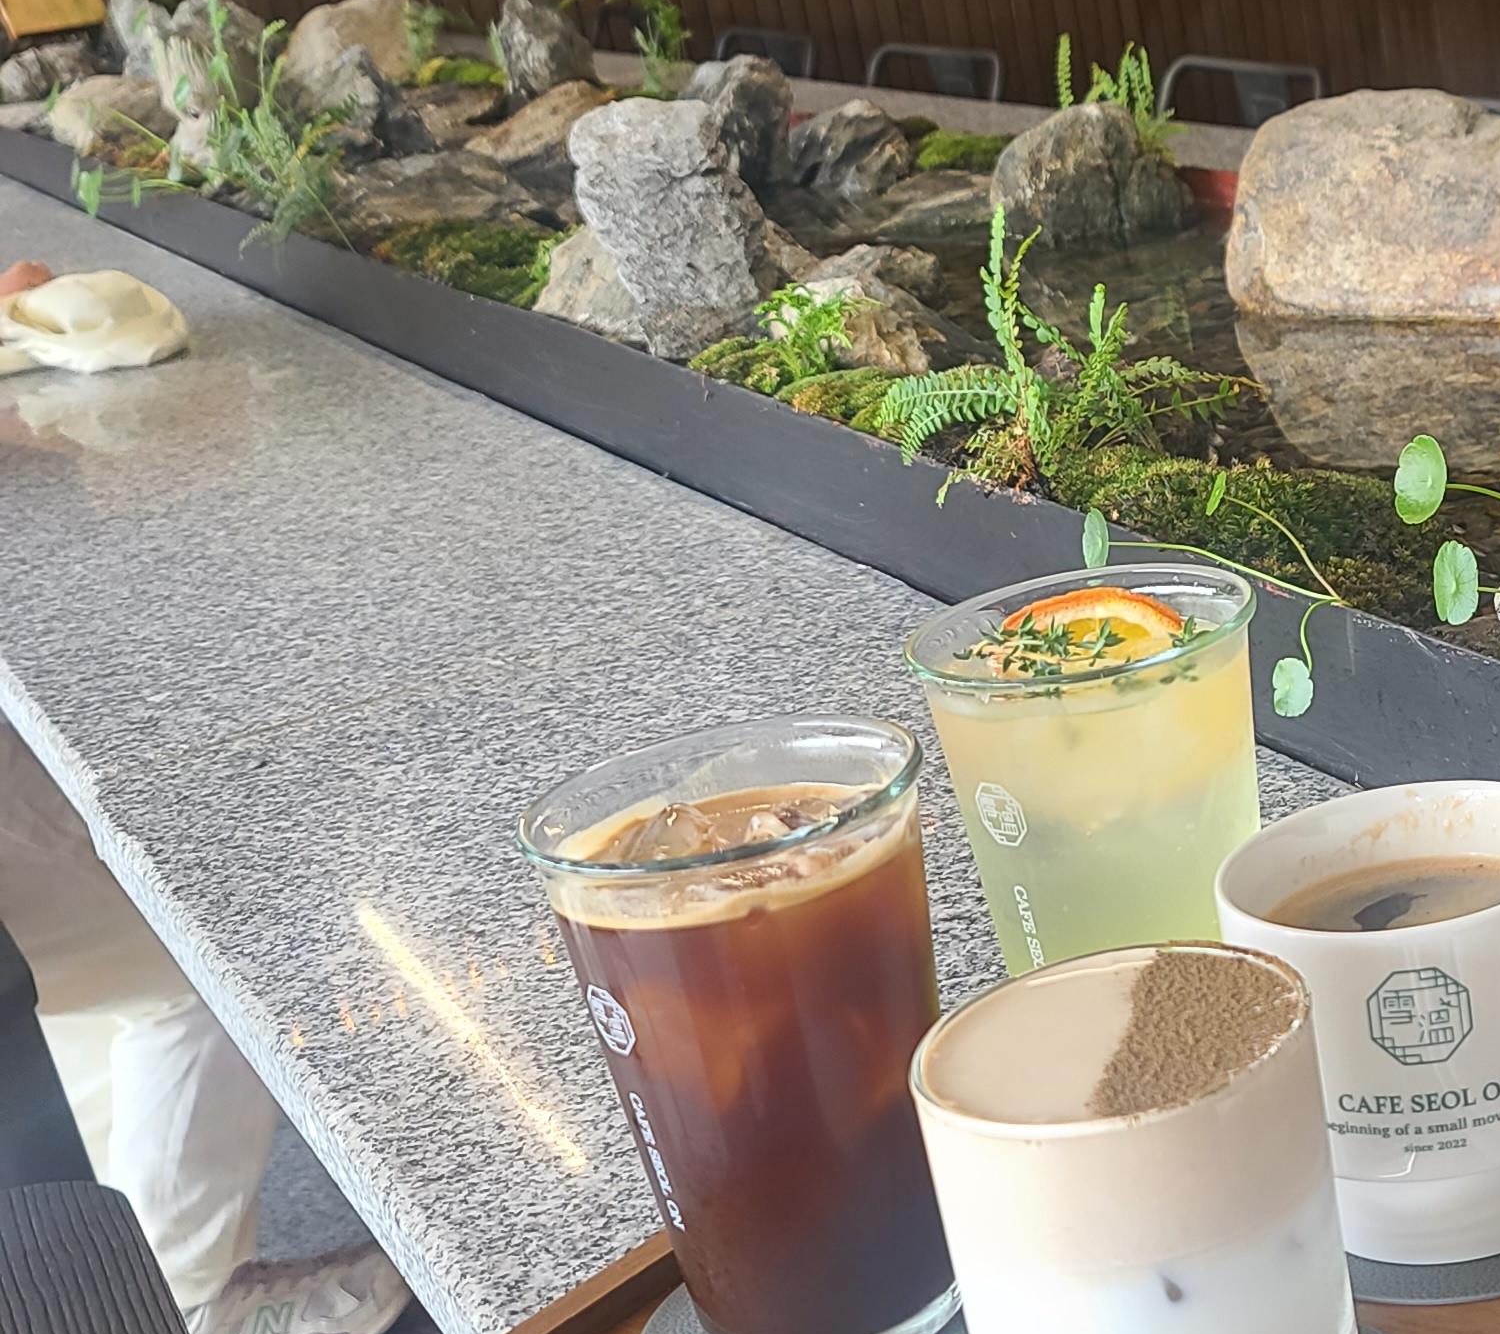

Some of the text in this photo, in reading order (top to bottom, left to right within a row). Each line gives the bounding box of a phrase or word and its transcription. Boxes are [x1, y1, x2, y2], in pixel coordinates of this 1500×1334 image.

[1338, 1093, 1404, 1115] CAFE
[1410, 1088, 1477, 1114] SEOL
[1395, 1123, 1411, 1136] of
[1414, 1126, 1423, 1135] a
[1427, 1117, 1468, 1134] small
[1404, 1138, 1468, 1153] since 2022
